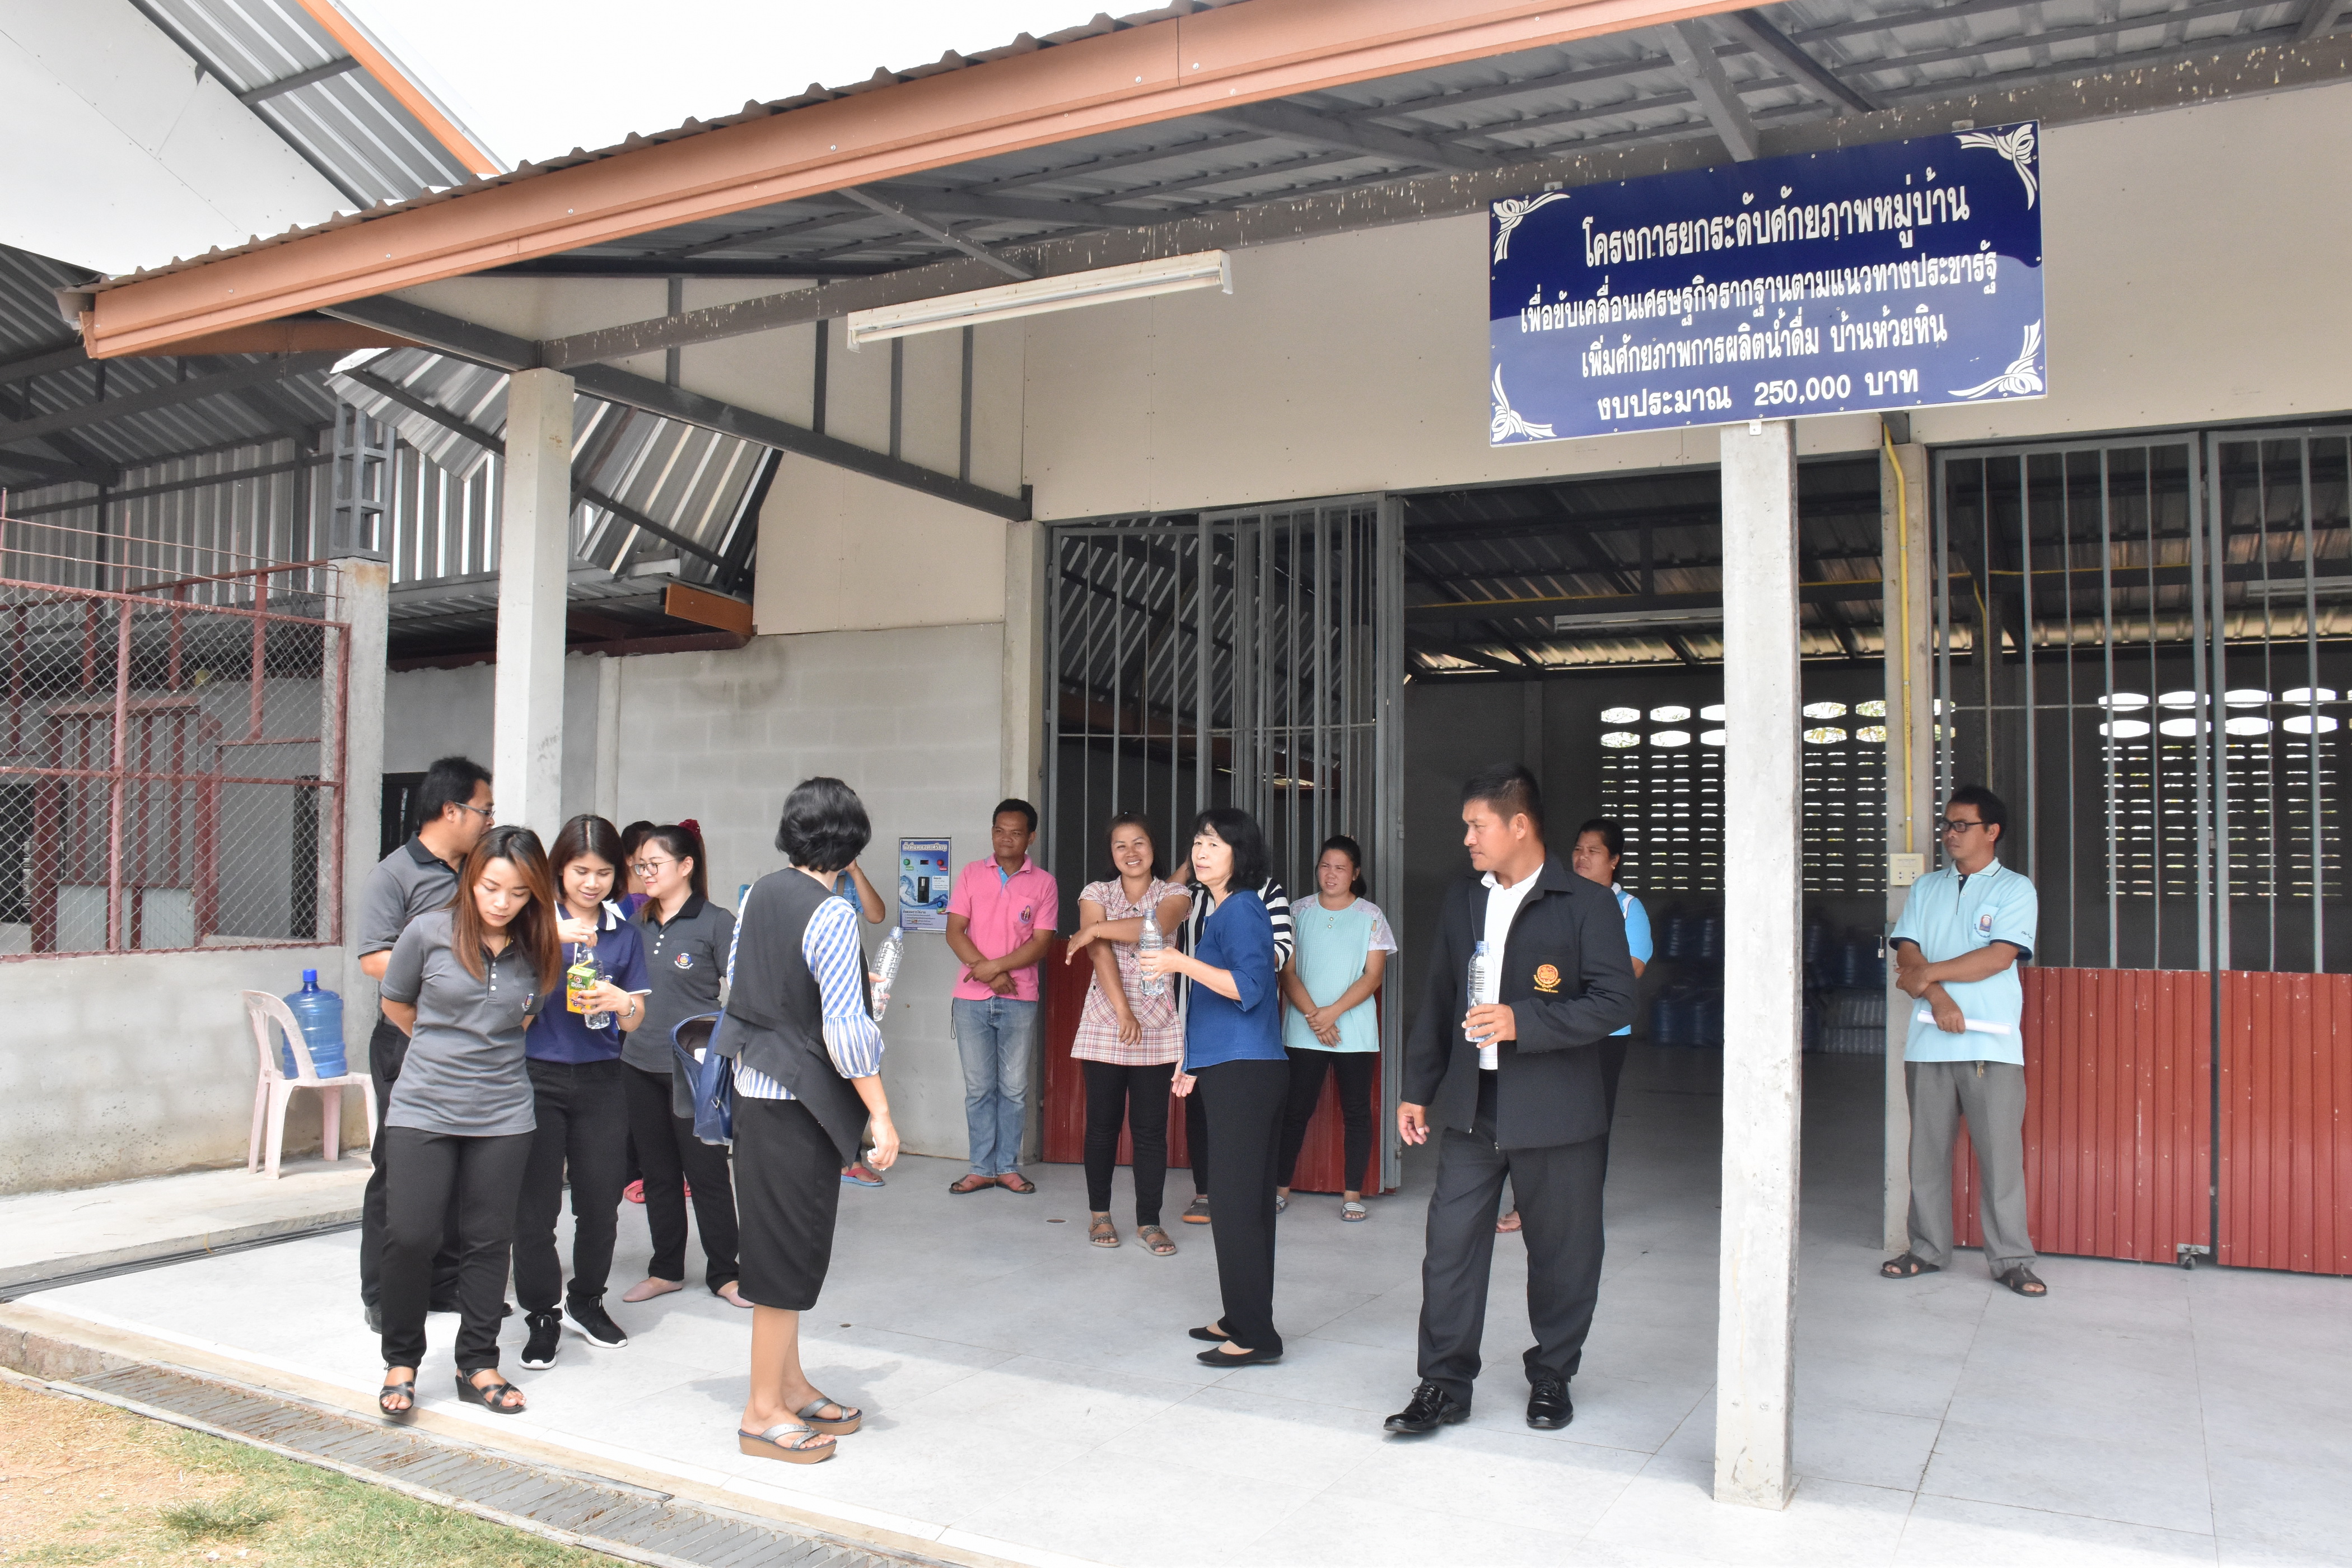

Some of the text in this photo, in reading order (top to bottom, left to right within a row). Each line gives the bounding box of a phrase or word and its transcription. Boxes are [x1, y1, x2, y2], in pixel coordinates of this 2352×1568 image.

[1581, 167, 1970, 268] โครงการยกระดับศักยภาพหมู่บ้าน
[1520, 240, 1998, 334] เพื่อขับเคลื่อนเศรษฐกิจรากฐานตามแนวทางประชารัฐ
[1582, 303, 1948, 379] เพิ่มศักยภาพการผลิตน้ำดื่ม บ้านห้วยหิน
[1597, 368, 1919, 421] งบประมาณ 250,000 บาท
